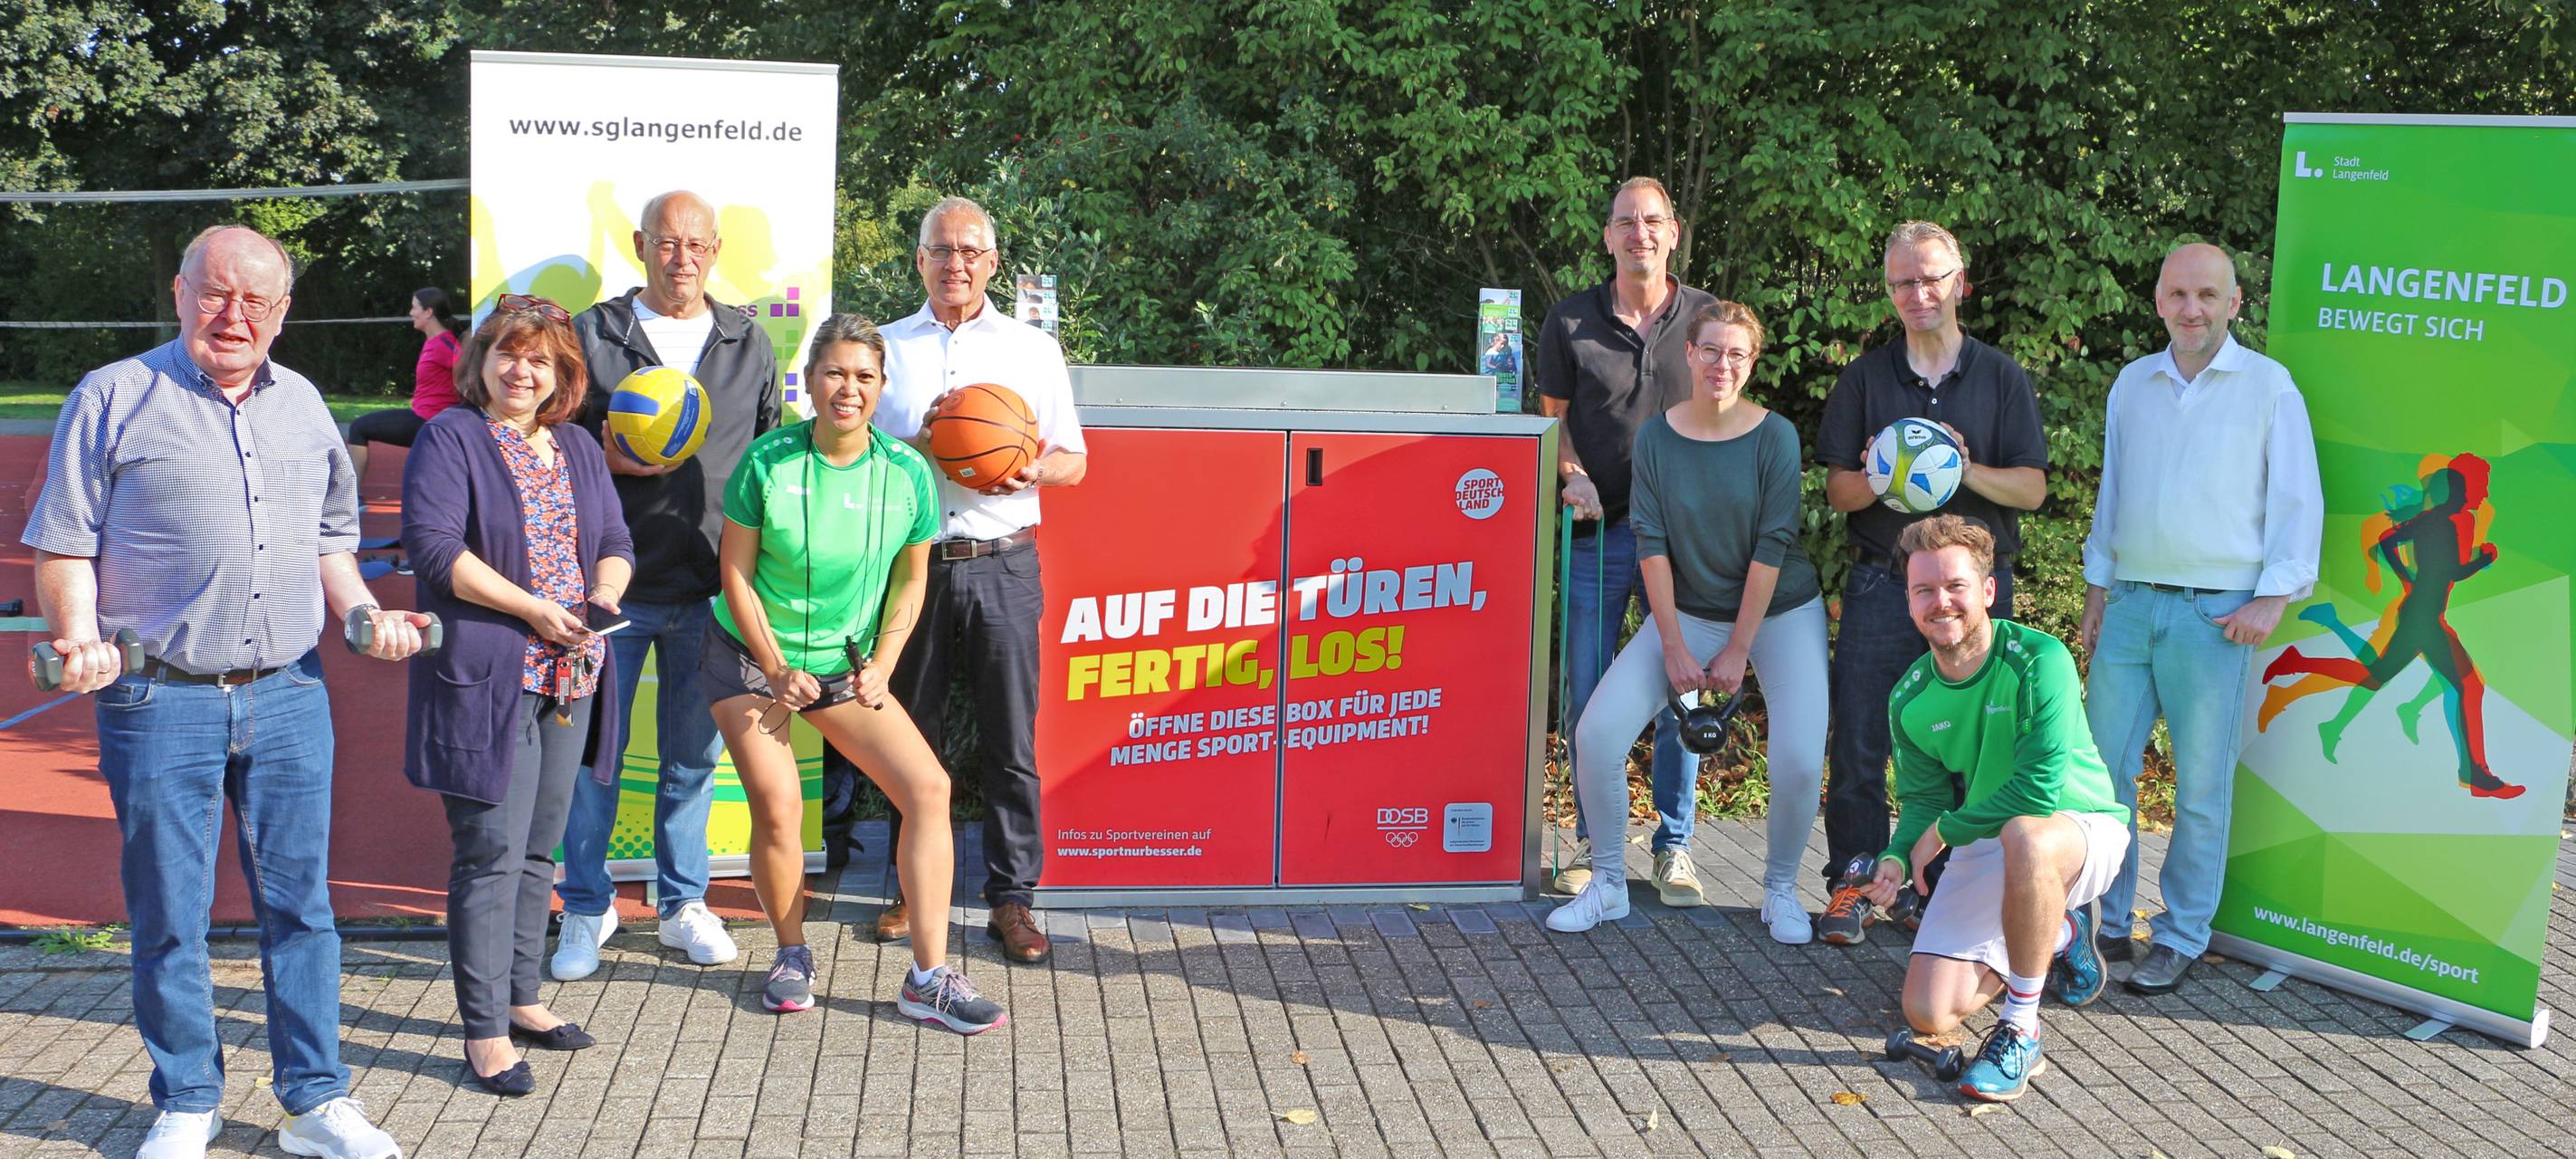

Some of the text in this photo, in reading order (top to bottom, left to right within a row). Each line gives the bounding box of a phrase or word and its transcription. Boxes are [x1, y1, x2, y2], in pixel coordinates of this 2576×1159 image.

[509, 116, 803, 143] www.sglangenfeld.de
[2333, 156, 2361, 168] Stadt
[2332, 168, 2390, 182] Langenfeld
[2321, 262, 2569, 310] LANGENFELD
[2317, 306, 2485, 342] BEWEGT SICH
[1455, 487, 1505, 501] DEUTSCH
[1463, 477, 1502, 491] SPORT
[1458, 499, 1490, 511] LAND
[1060, 556, 1488, 645] AUF DIE TÜREN,
[1066, 625, 1406, 702] FERTIG, LOS!
[1128, 687, 1442, 739] ÖFFNE DIESE BOX FÜR JEDE
[1110, 739, 1192, 767] MENGE
[1377, 808, 1429, 824] DOSB
[1057, 828, 1213, 843] Infos zu Sportvereinen auf
[1056, 845, 1203, 859] www.sportnurbesser.de
[2253, 905, 2481, 985] www.langenfeld.de/sport
